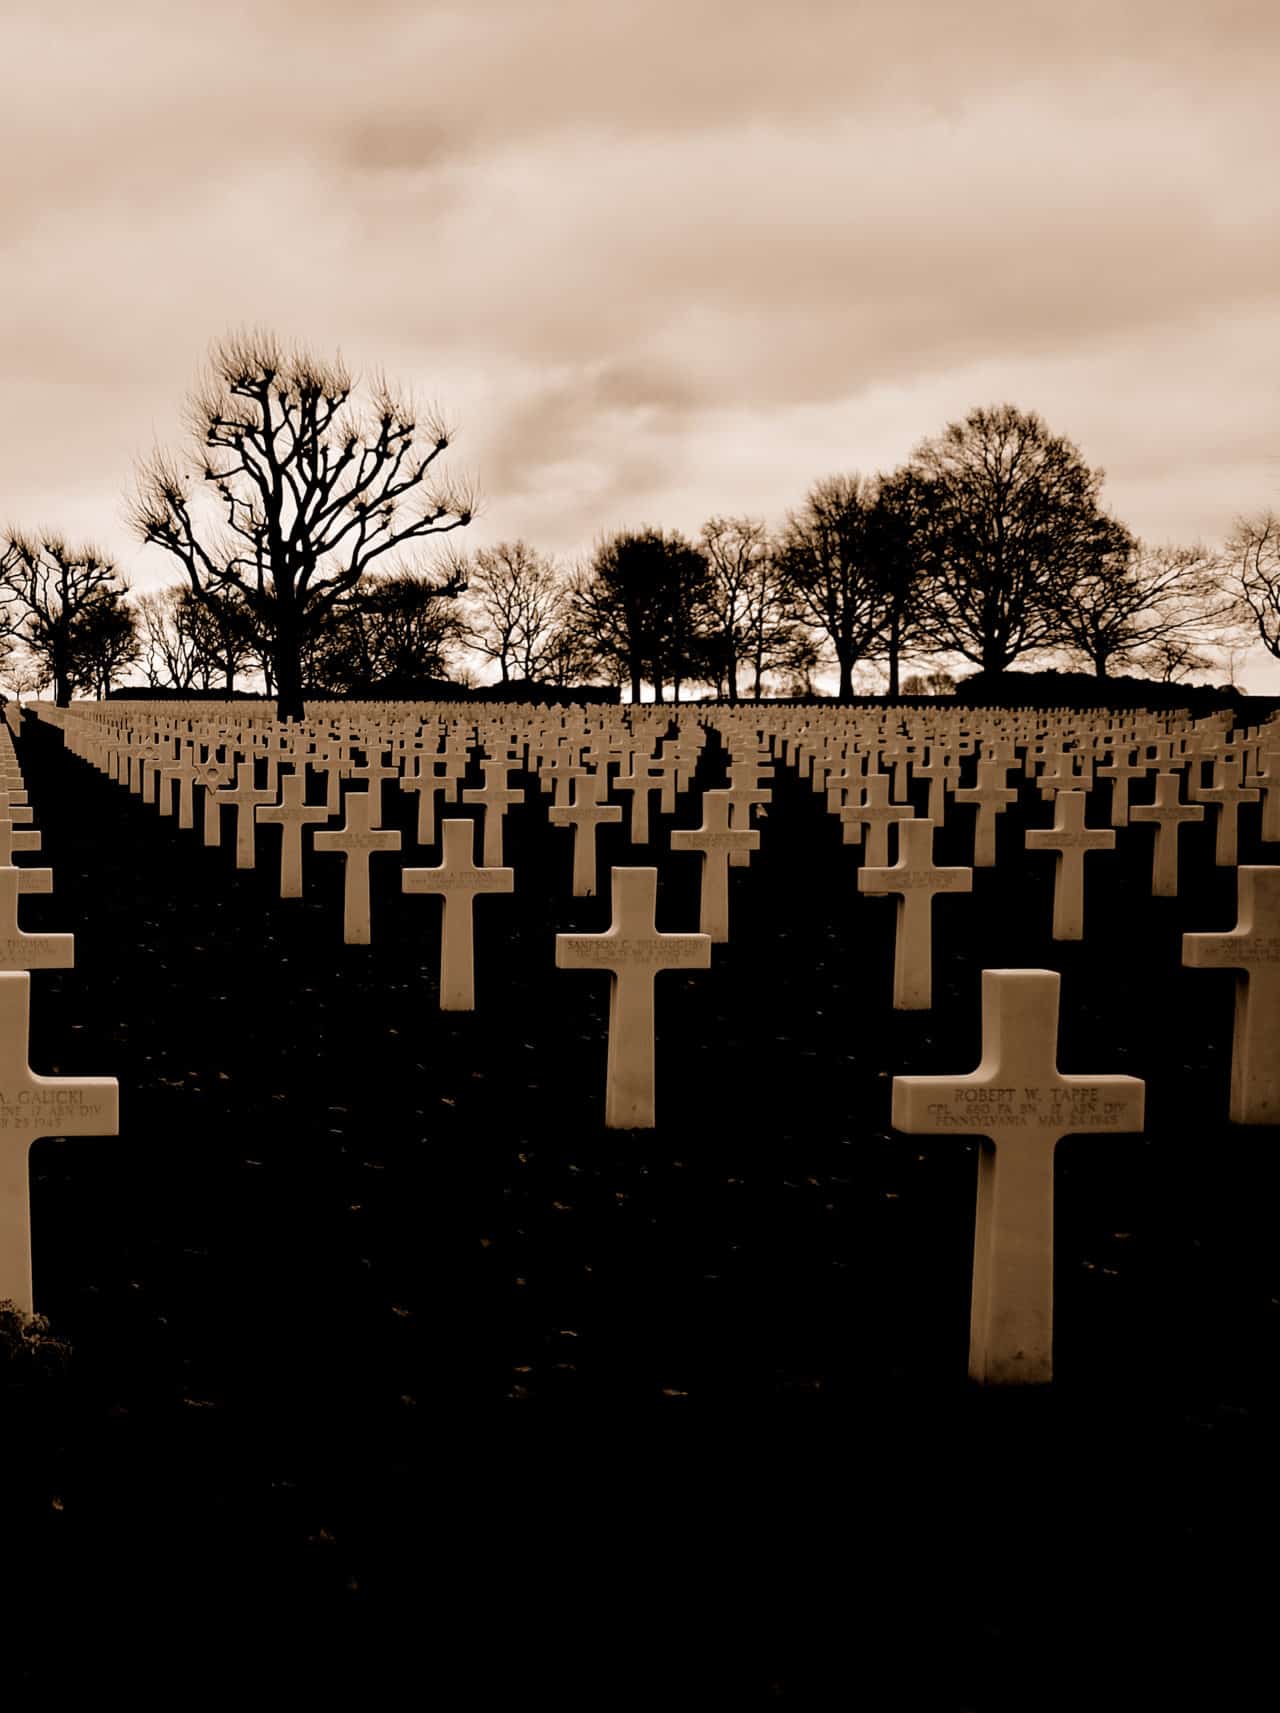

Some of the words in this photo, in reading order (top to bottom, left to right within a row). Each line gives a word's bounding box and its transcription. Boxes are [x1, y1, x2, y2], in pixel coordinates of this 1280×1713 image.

[17, 1090, 83, 1105] GALICKI
[954, 1087, 1016, 1103] ROBERT
[1050, 1087, 1099, 1103] TAPPE
[927, 1103, 952, 1115] CPL
